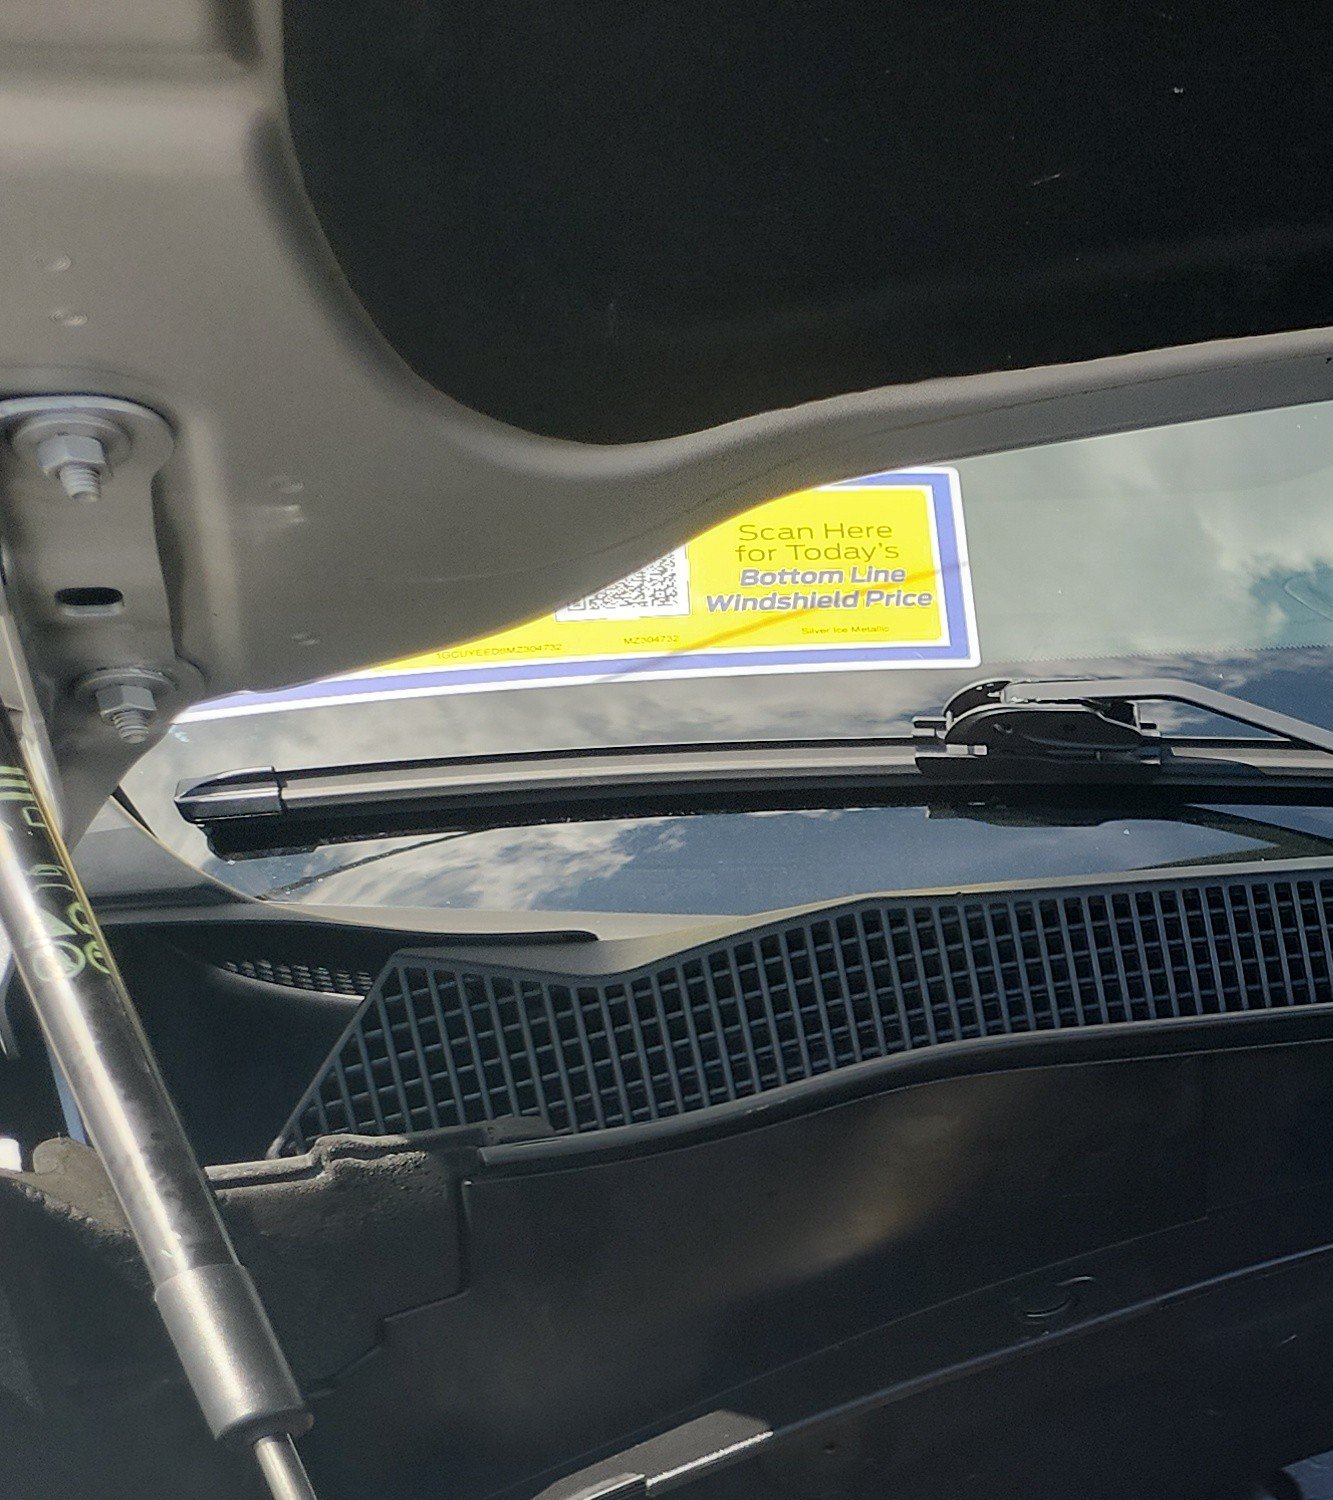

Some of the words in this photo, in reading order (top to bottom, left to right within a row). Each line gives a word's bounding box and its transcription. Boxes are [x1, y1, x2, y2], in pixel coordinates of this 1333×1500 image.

[739, 524, 814, 541] Scan
[824, 522, 893, 539] Here
[735, 544, 777, 562] for
[786, 542, 900, 563] Today's
[739, 567, 844, 587] Bottom
[850, 565, 906, 584] Line
[706, 590, 860, 612] Windshield
[865, 589, 933, 607] Price
[623, 634, 680, 645] MZ304732
[801, 625, 830, 635] Silver
